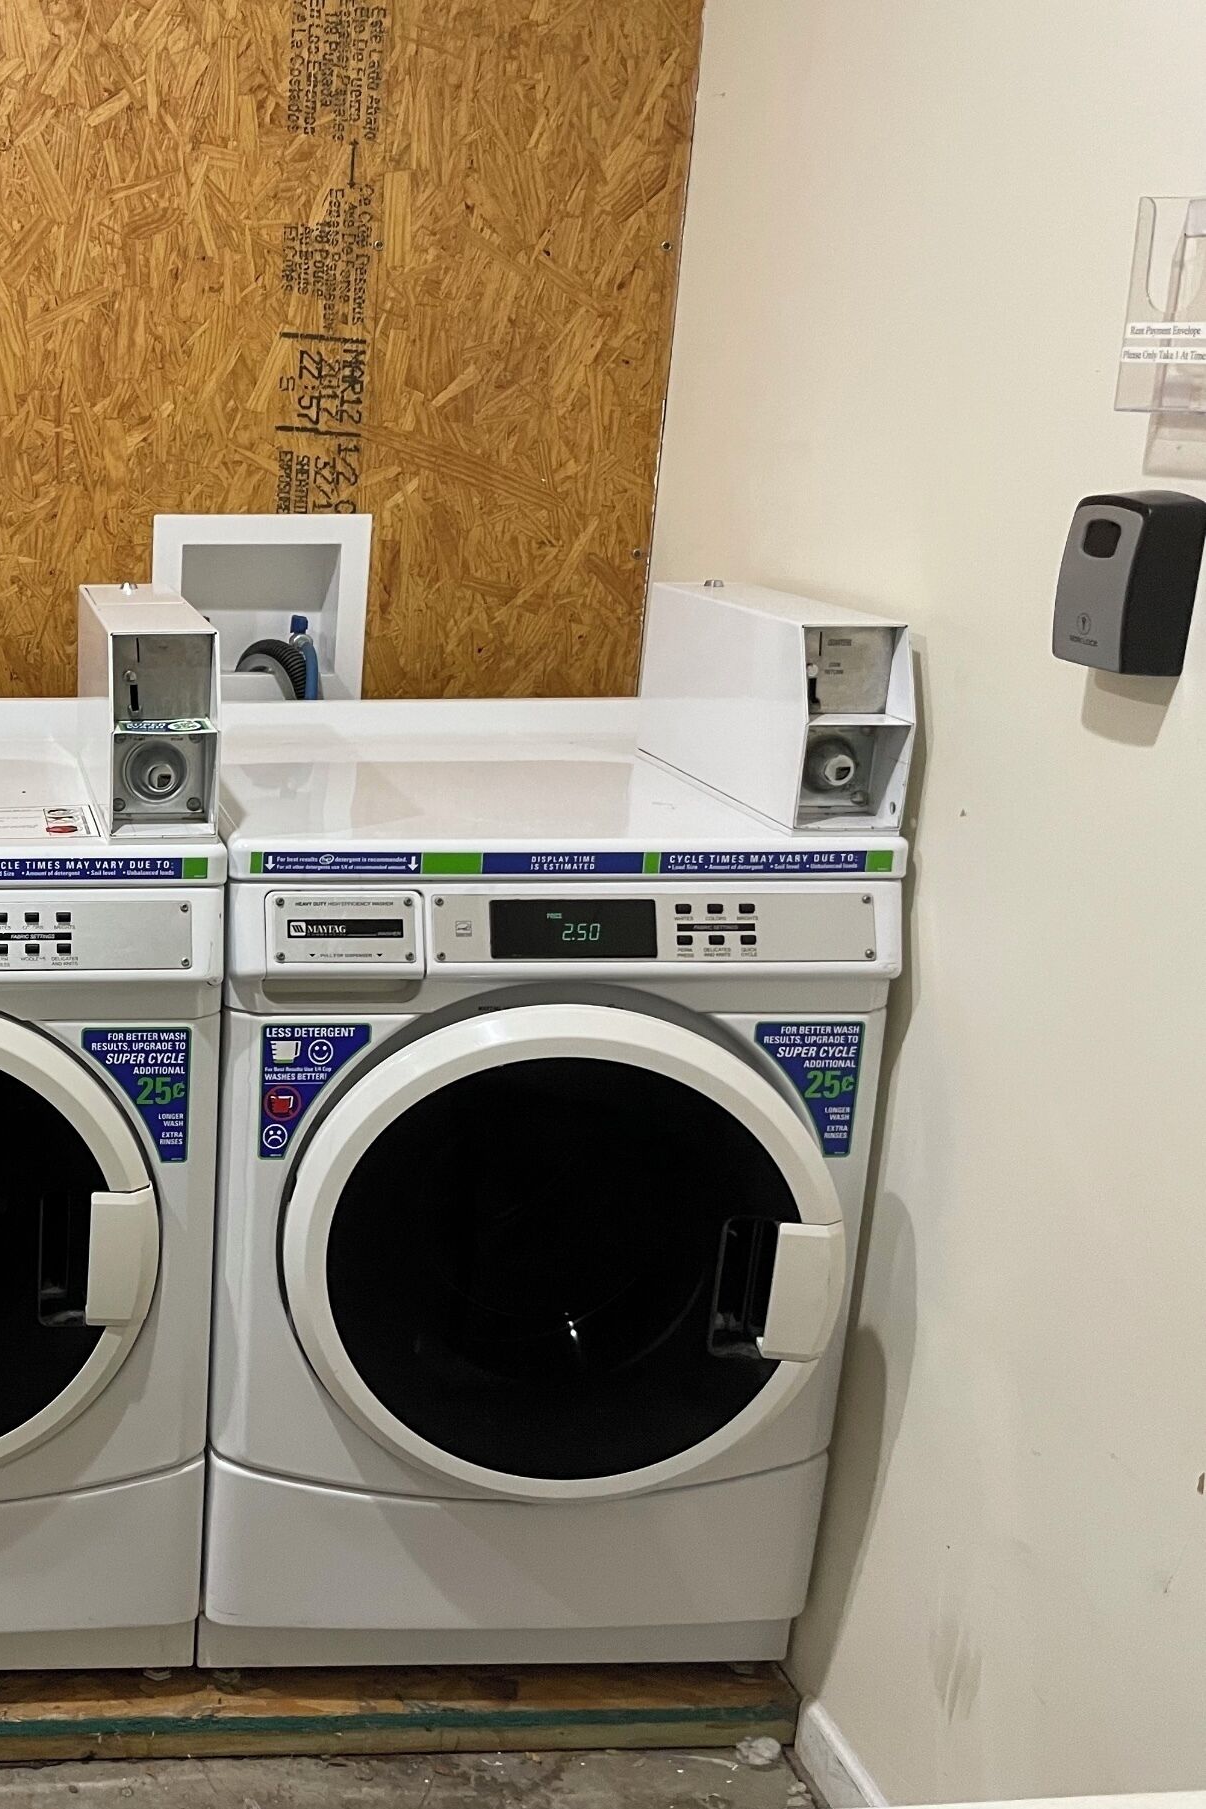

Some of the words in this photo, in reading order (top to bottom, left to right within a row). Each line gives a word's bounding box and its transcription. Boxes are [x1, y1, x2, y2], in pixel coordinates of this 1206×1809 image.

[1172, 325, 1201, 338] Envelope
[1159, 350, 1174, 359] Take
[669, 855, 704, 863] CYCLE
[709, 855, 745, 863] TIMES
[750, 855, 774, 863] MAY
[779, 854, 807, 862] VARY
[813, 854, 835, 862] DUE
[25, 861, 60, 869] TIMES
[66, 861, 90, 869] MAY
[95, 861, 124, 869] VARY
[129, 861, 151, 869] DUE
[157, 861, 174, 869] TO:
[307, 925, 346, 933] MAYTAG
[562, 923, 601, 941] 2.50
[266, 1027, 291, 1037] LESS
[294, 1027, 355, 1037] DETERGENT
[780, 1026, 797, 1034] FOR
[798, 1026, 831, 1034] BETTER
[833, 1026, 860, 1034] WASH
[107, 1033, 124, 1041] FOR
[125, 1033, 158, 1041] BETTER
[160, 1033, 186, 1041] WASH
[763, 1035, 803, 1044] RESULTS,
[804, 1035, 844, 1044] UPGRADE
[847, 1035, 859, 1044] TO
[91, 1042, 130, 1051] RESULTS,
[132, 1042, 173, 1050] UPGRADE
[175, 1042, 186, 1050] TO
[776, 1047, 817, 1057] SUPER
[819, 1047, 858, 1057] CYCLE
[105, 1053, 145, 1064] SUPER
[148, 1053, 185, 1064] CYCLE
[803, 1060, 856, 1068] ADDITIONAL
[133, 1066, 185, 1074] ADDITIONAL
[136, 1077, 185, 1105] 25¢
